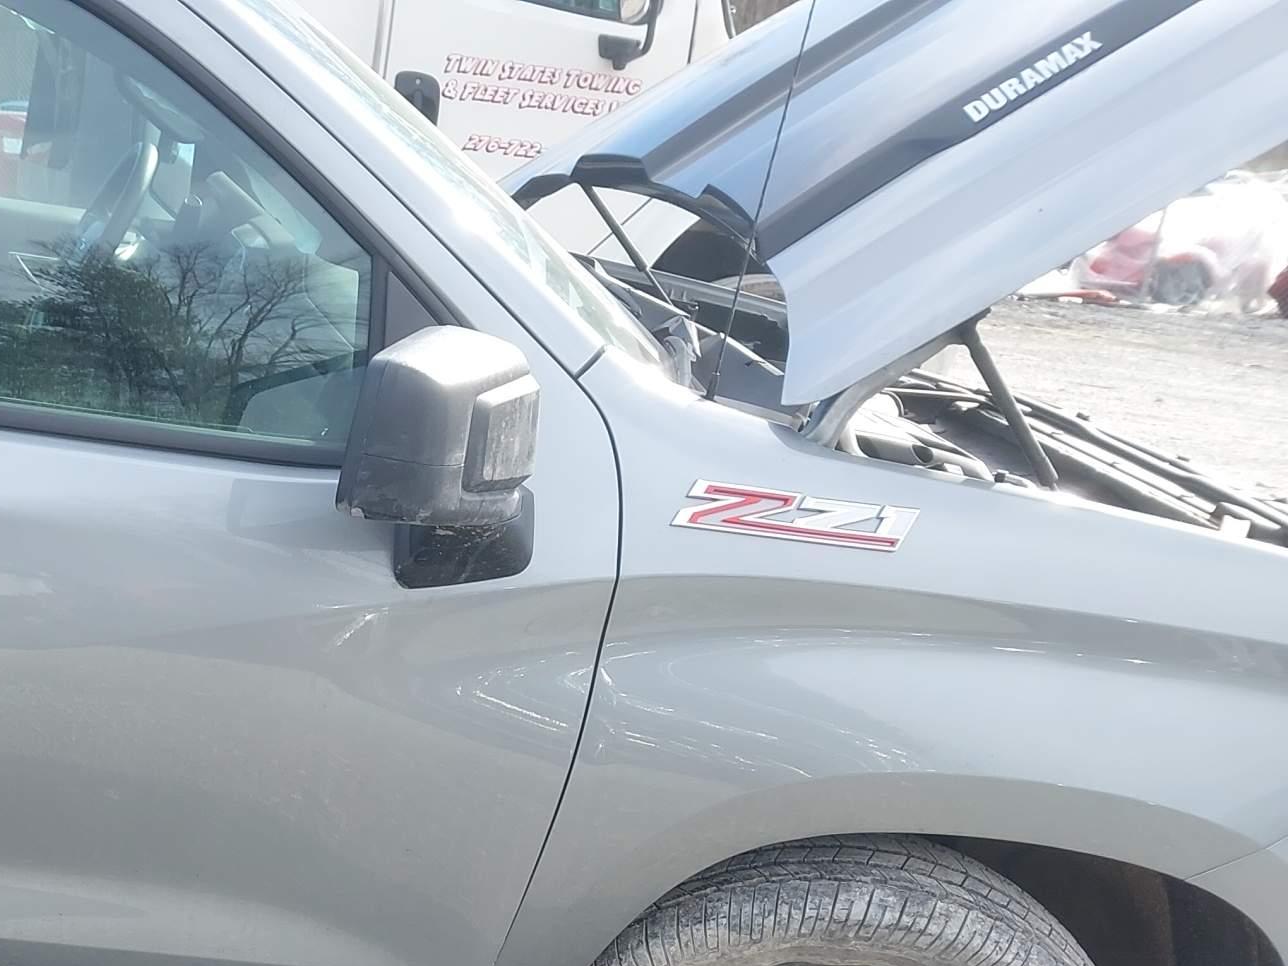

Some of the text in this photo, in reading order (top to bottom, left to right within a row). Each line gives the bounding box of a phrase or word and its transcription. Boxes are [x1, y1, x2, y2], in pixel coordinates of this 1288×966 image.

[442, 79, 458, 100] &
[460, 83, 518, 104] FLEET
[519, 91, 604, 116] SERVICES
[444, 53, 642, 95] TWIN STATES TOWING
[963, 31, 1103, 123] DURAMAX
[669, 479, 920, 552] Z71
